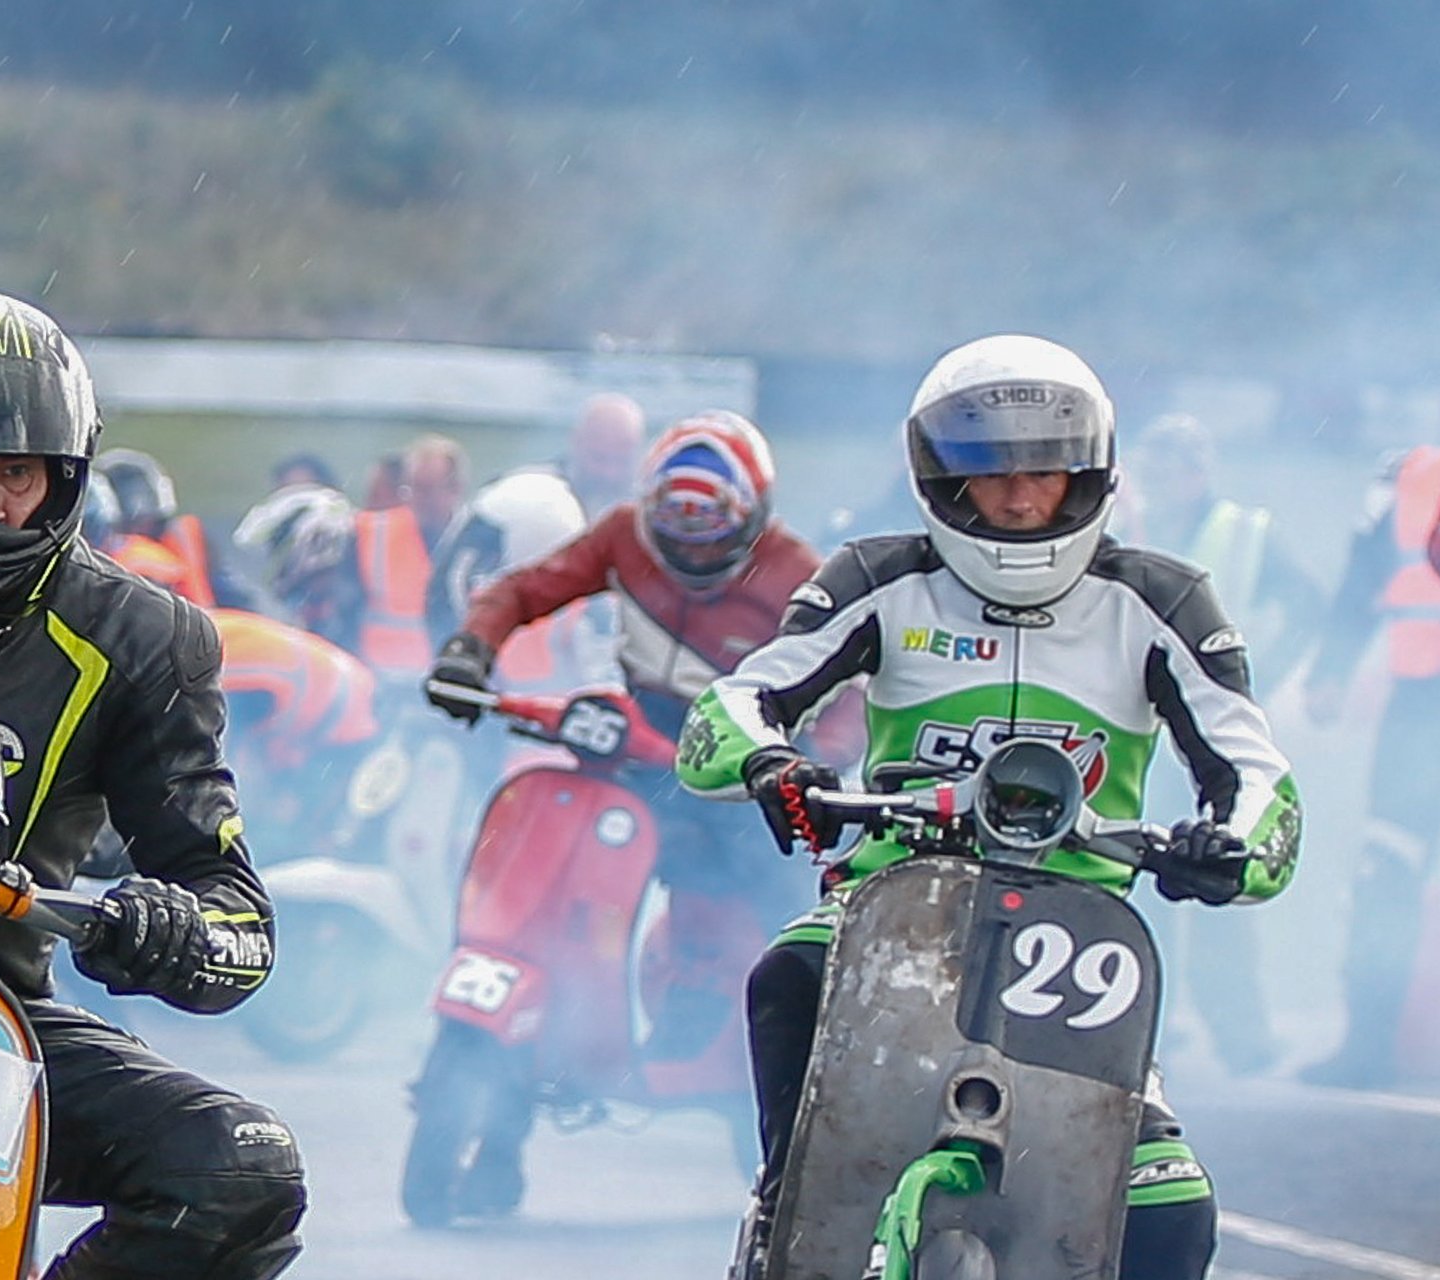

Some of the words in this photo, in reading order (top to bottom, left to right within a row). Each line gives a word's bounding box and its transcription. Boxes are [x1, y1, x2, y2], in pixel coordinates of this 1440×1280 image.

[991, 388, 1047, 404] SHOEI
[902, 628, 999, 661] MERU
[445, 952, 520, 1013] 26
[998, 922, 1142, 1030] 29
